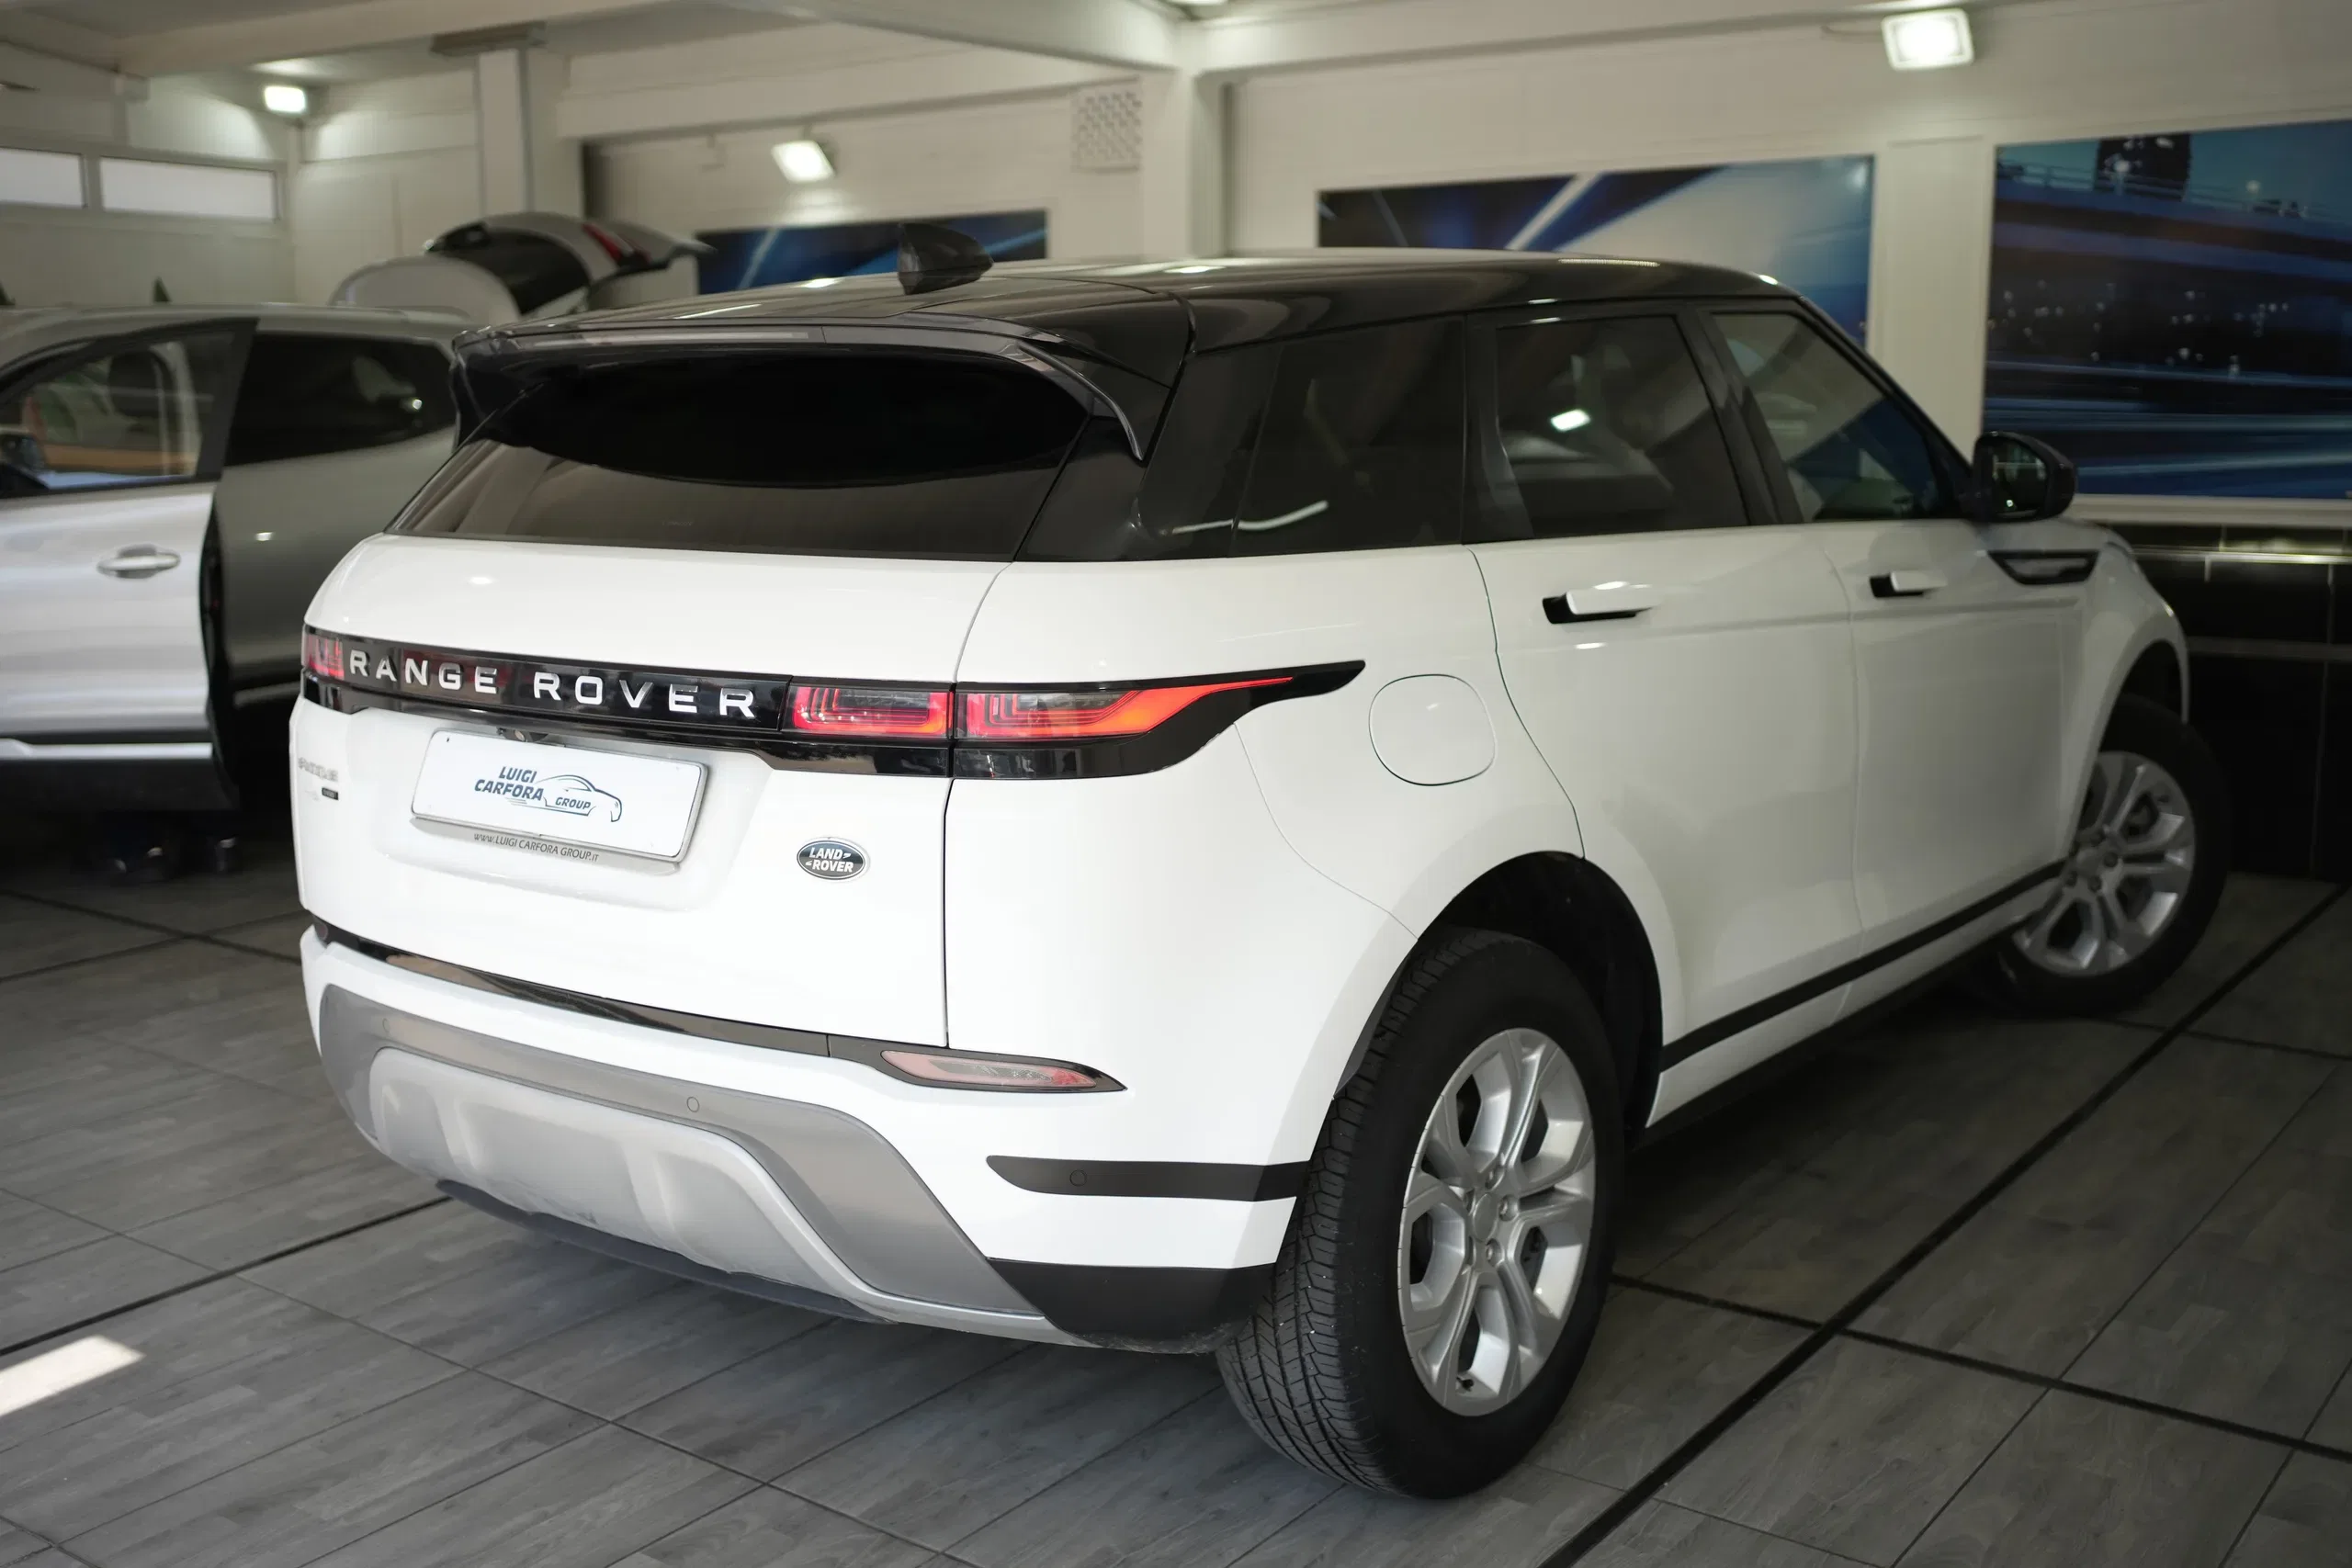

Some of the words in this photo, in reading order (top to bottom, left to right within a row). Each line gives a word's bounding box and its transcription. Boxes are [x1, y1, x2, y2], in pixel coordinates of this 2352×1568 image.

[349, 649, 499, 694] RANGE
[533, 671, 757, 718] ROVER
[498, 766, 537, 784] LUIGI
[474, 779, 544, 801] CARFORA
[555, 796, 591, 810] GROUP
[518, 839, 559, 854] CARFORA
[808, 847, 843, 860] LAND
[812, 859, 854, 873] ROVER
